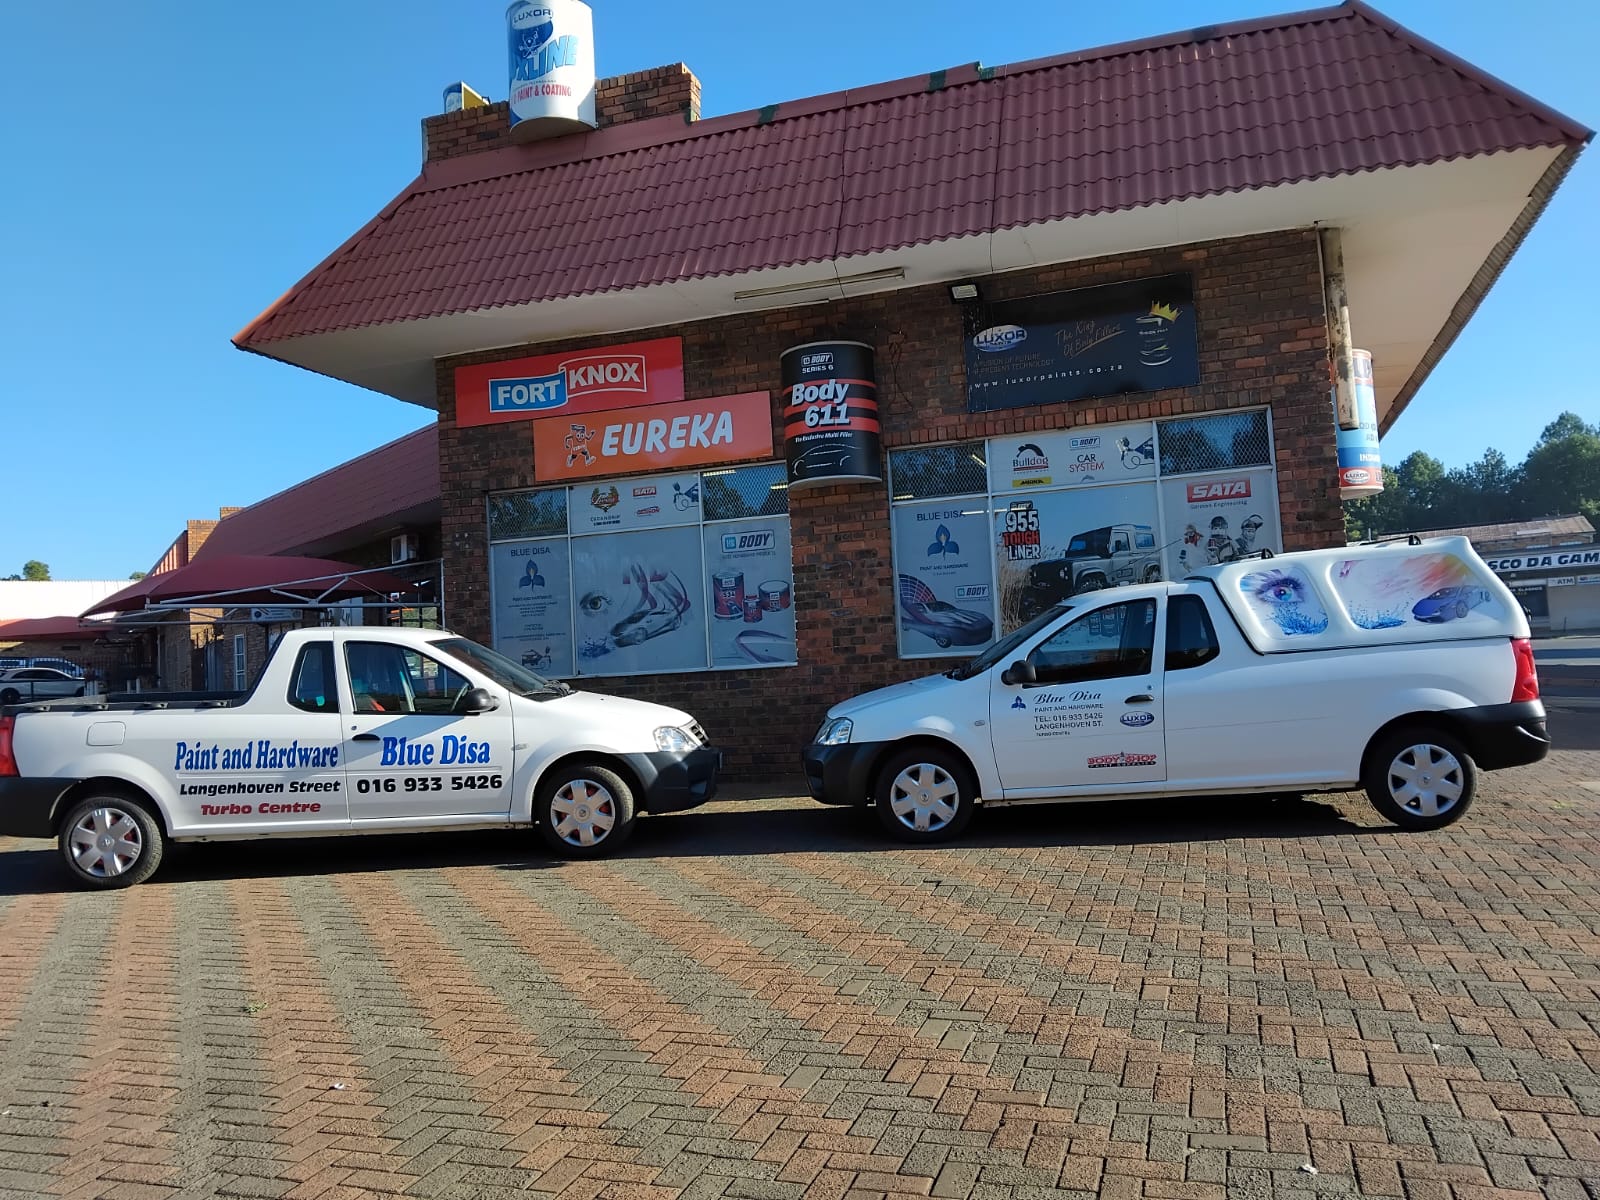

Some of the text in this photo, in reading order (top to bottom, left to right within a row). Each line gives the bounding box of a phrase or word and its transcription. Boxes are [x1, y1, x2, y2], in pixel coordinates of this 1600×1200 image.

[513, 8, 552, 23] LUXOR
[535, 85, 540, 96] &
[976, 330, 1025, 345] LUXOR
[811, 355, 830, 363] BODY
[802, 366, 827, 374] SERIES
[497, 362, 641, 406] FORT KNOX
[791, 379, 849, 405] Body
[804, 403, 850, 427] 611
[601, 411, 733, 456] EUREKA
[1012, 456, 1049, 468] Bulldog
[1077, 453, 1097, 463] CAR
[1069, 462, 1105, 473] SYSTEM
[634, 488, 656, 496] SATA
[1192, 481, 1247, 499] SATA
[916, 509, 966, 521] BLUE DISA
[1006, 510, 1039, 532] 955
[739, 533, 771, 549] BODY
[1003, 531, 1040, 546] TOUGH
[511, 547, 552, 557] BLUE DISA
[1008, 544, 1041, 560] LINER
[1526, 556, 1552, 567] DA
[1557, 577, 1574, 585] ATM
[966, 586, 987, 596] BODY
[1033, 690, 1102, 705] Blue Disa
[1034, 715, 1052, 723] TEL:
[1069, 713, 1083, 721] 933
[1084, 712, 1103, 720] 5426
[1123, 713, 1153, 722] LUXOR
[1034, 720, 1091, 731] LANGENHOVEN
[174, 740, 339, 771] Paint and Hardware
[380, 735, 491, 766] Blue Disa
[1087, 754, 1120, 765] BODY
[1125, 753, 1156, 763] SHOP
[180, 780, 341, 797] Langenhoven Street
[357, 774, 502, 794] 016 933 5426
[201, 801, 321, 816] Turbo Centre
